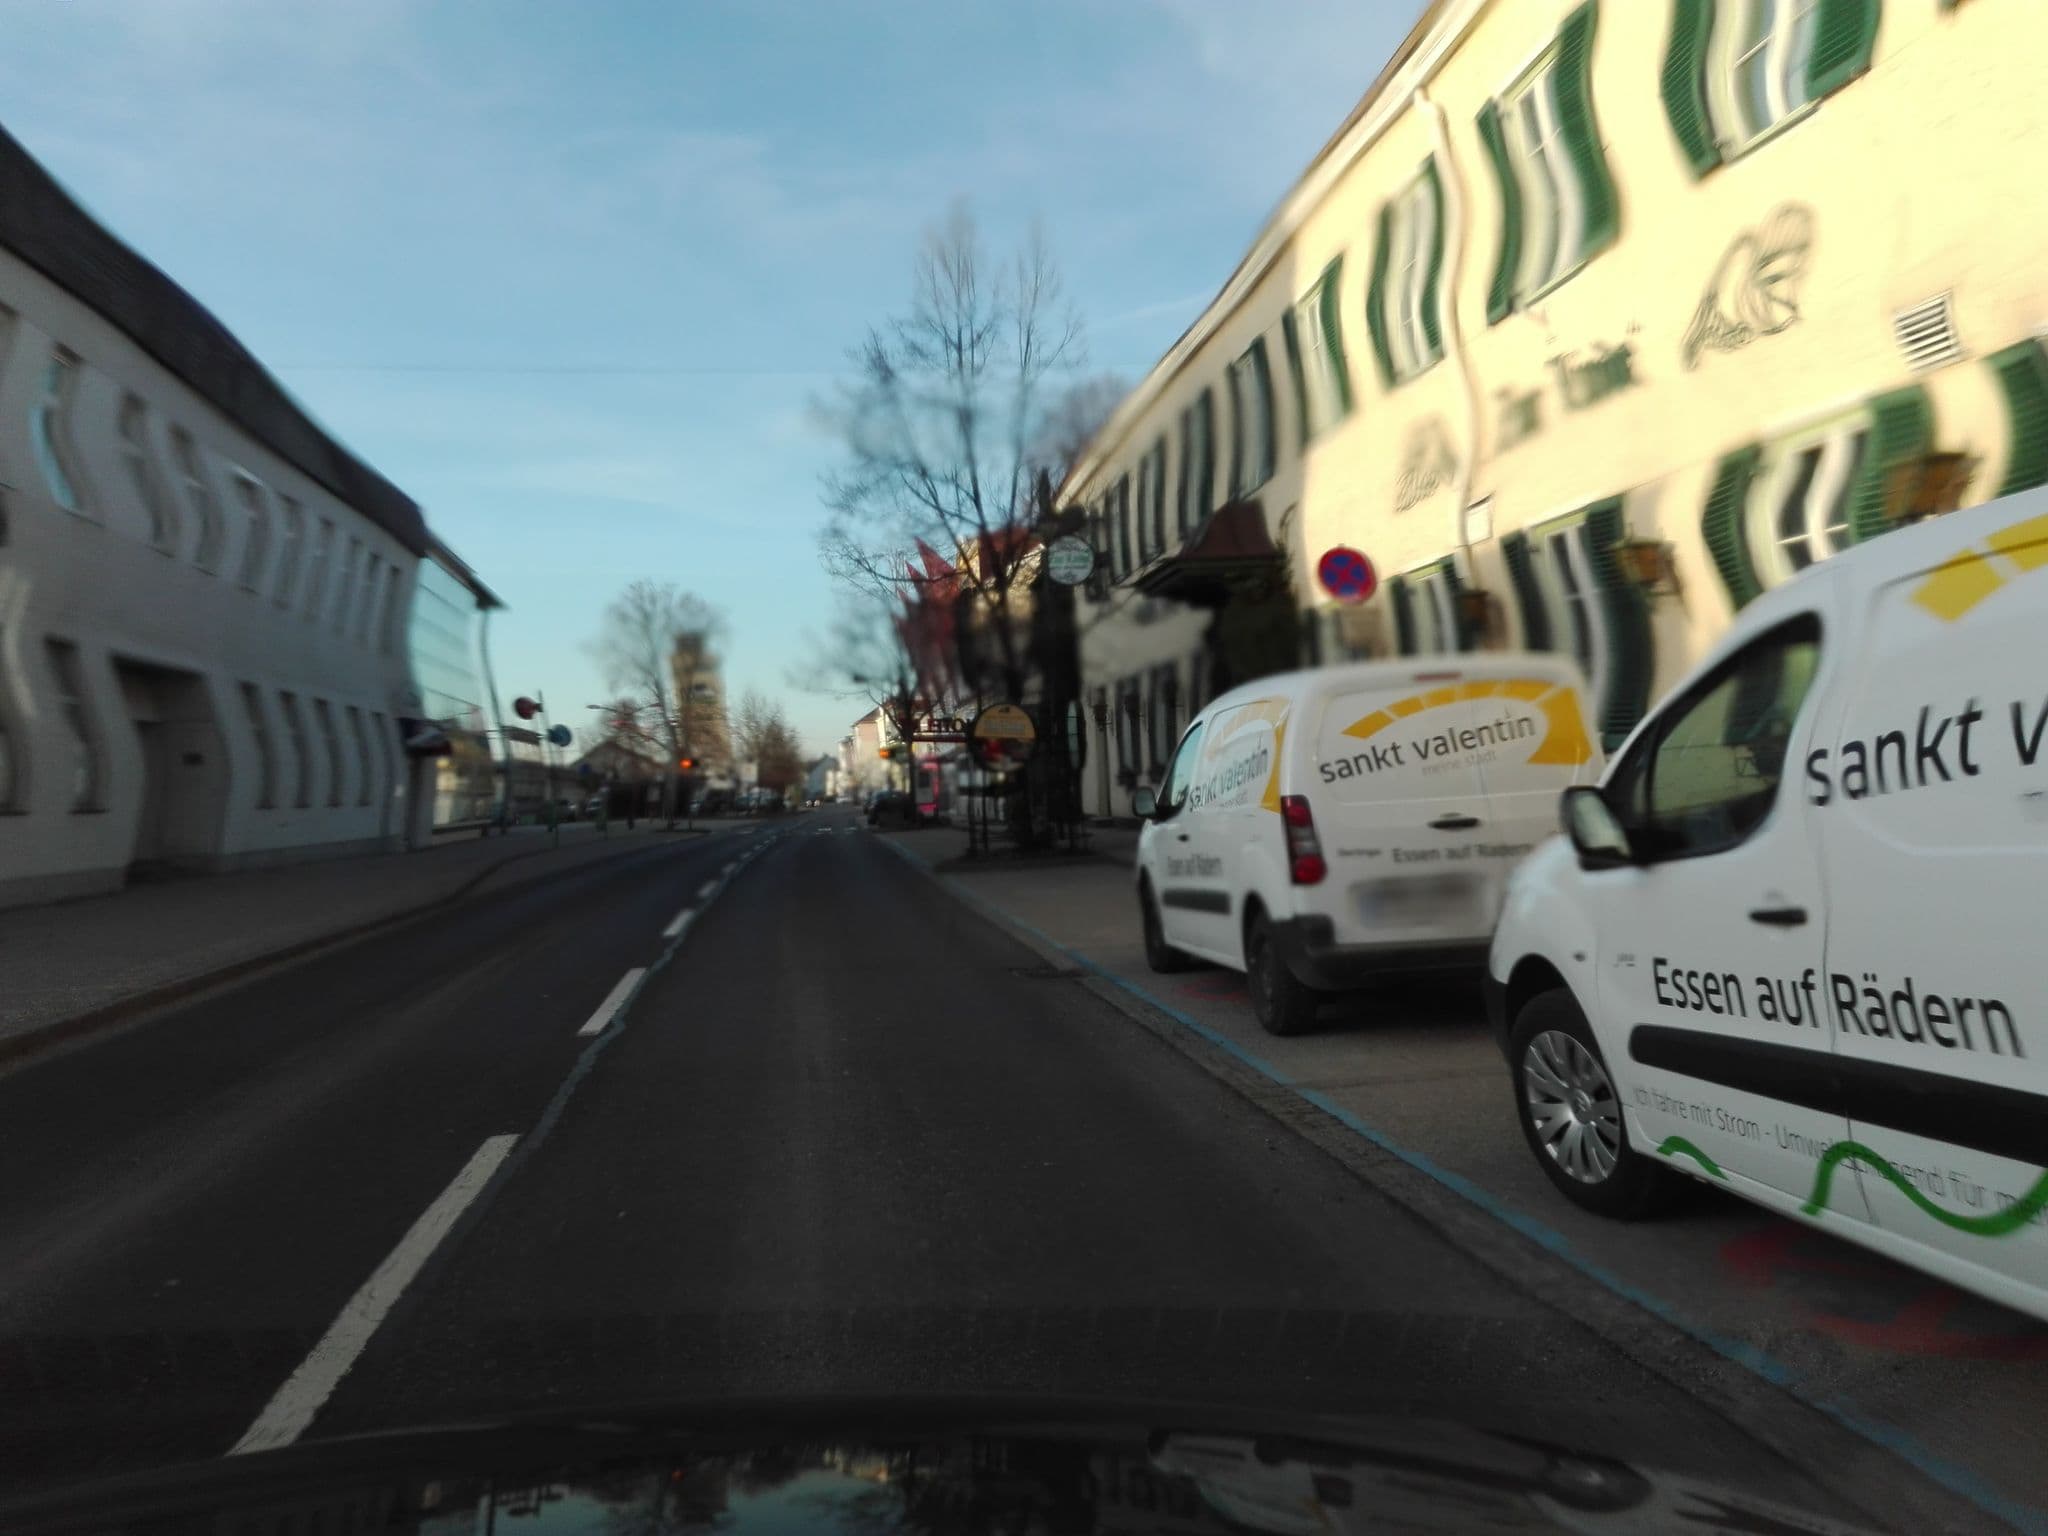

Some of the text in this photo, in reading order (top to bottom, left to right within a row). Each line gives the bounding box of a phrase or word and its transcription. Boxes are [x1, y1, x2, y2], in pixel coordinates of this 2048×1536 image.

[1189, 775, 1217, 813] sankt
[1221, 743, 1268, 795] valentin
[1318, 705, 1537, 784] sankt valentin
[1807, 698, 1983, 806] sankt
[1653, 957, 2027, 1059] Essen auf Rädern
[1690, 1103, 1714, 1128] mit
[1716, 1107, 1761, 1142] Strom
